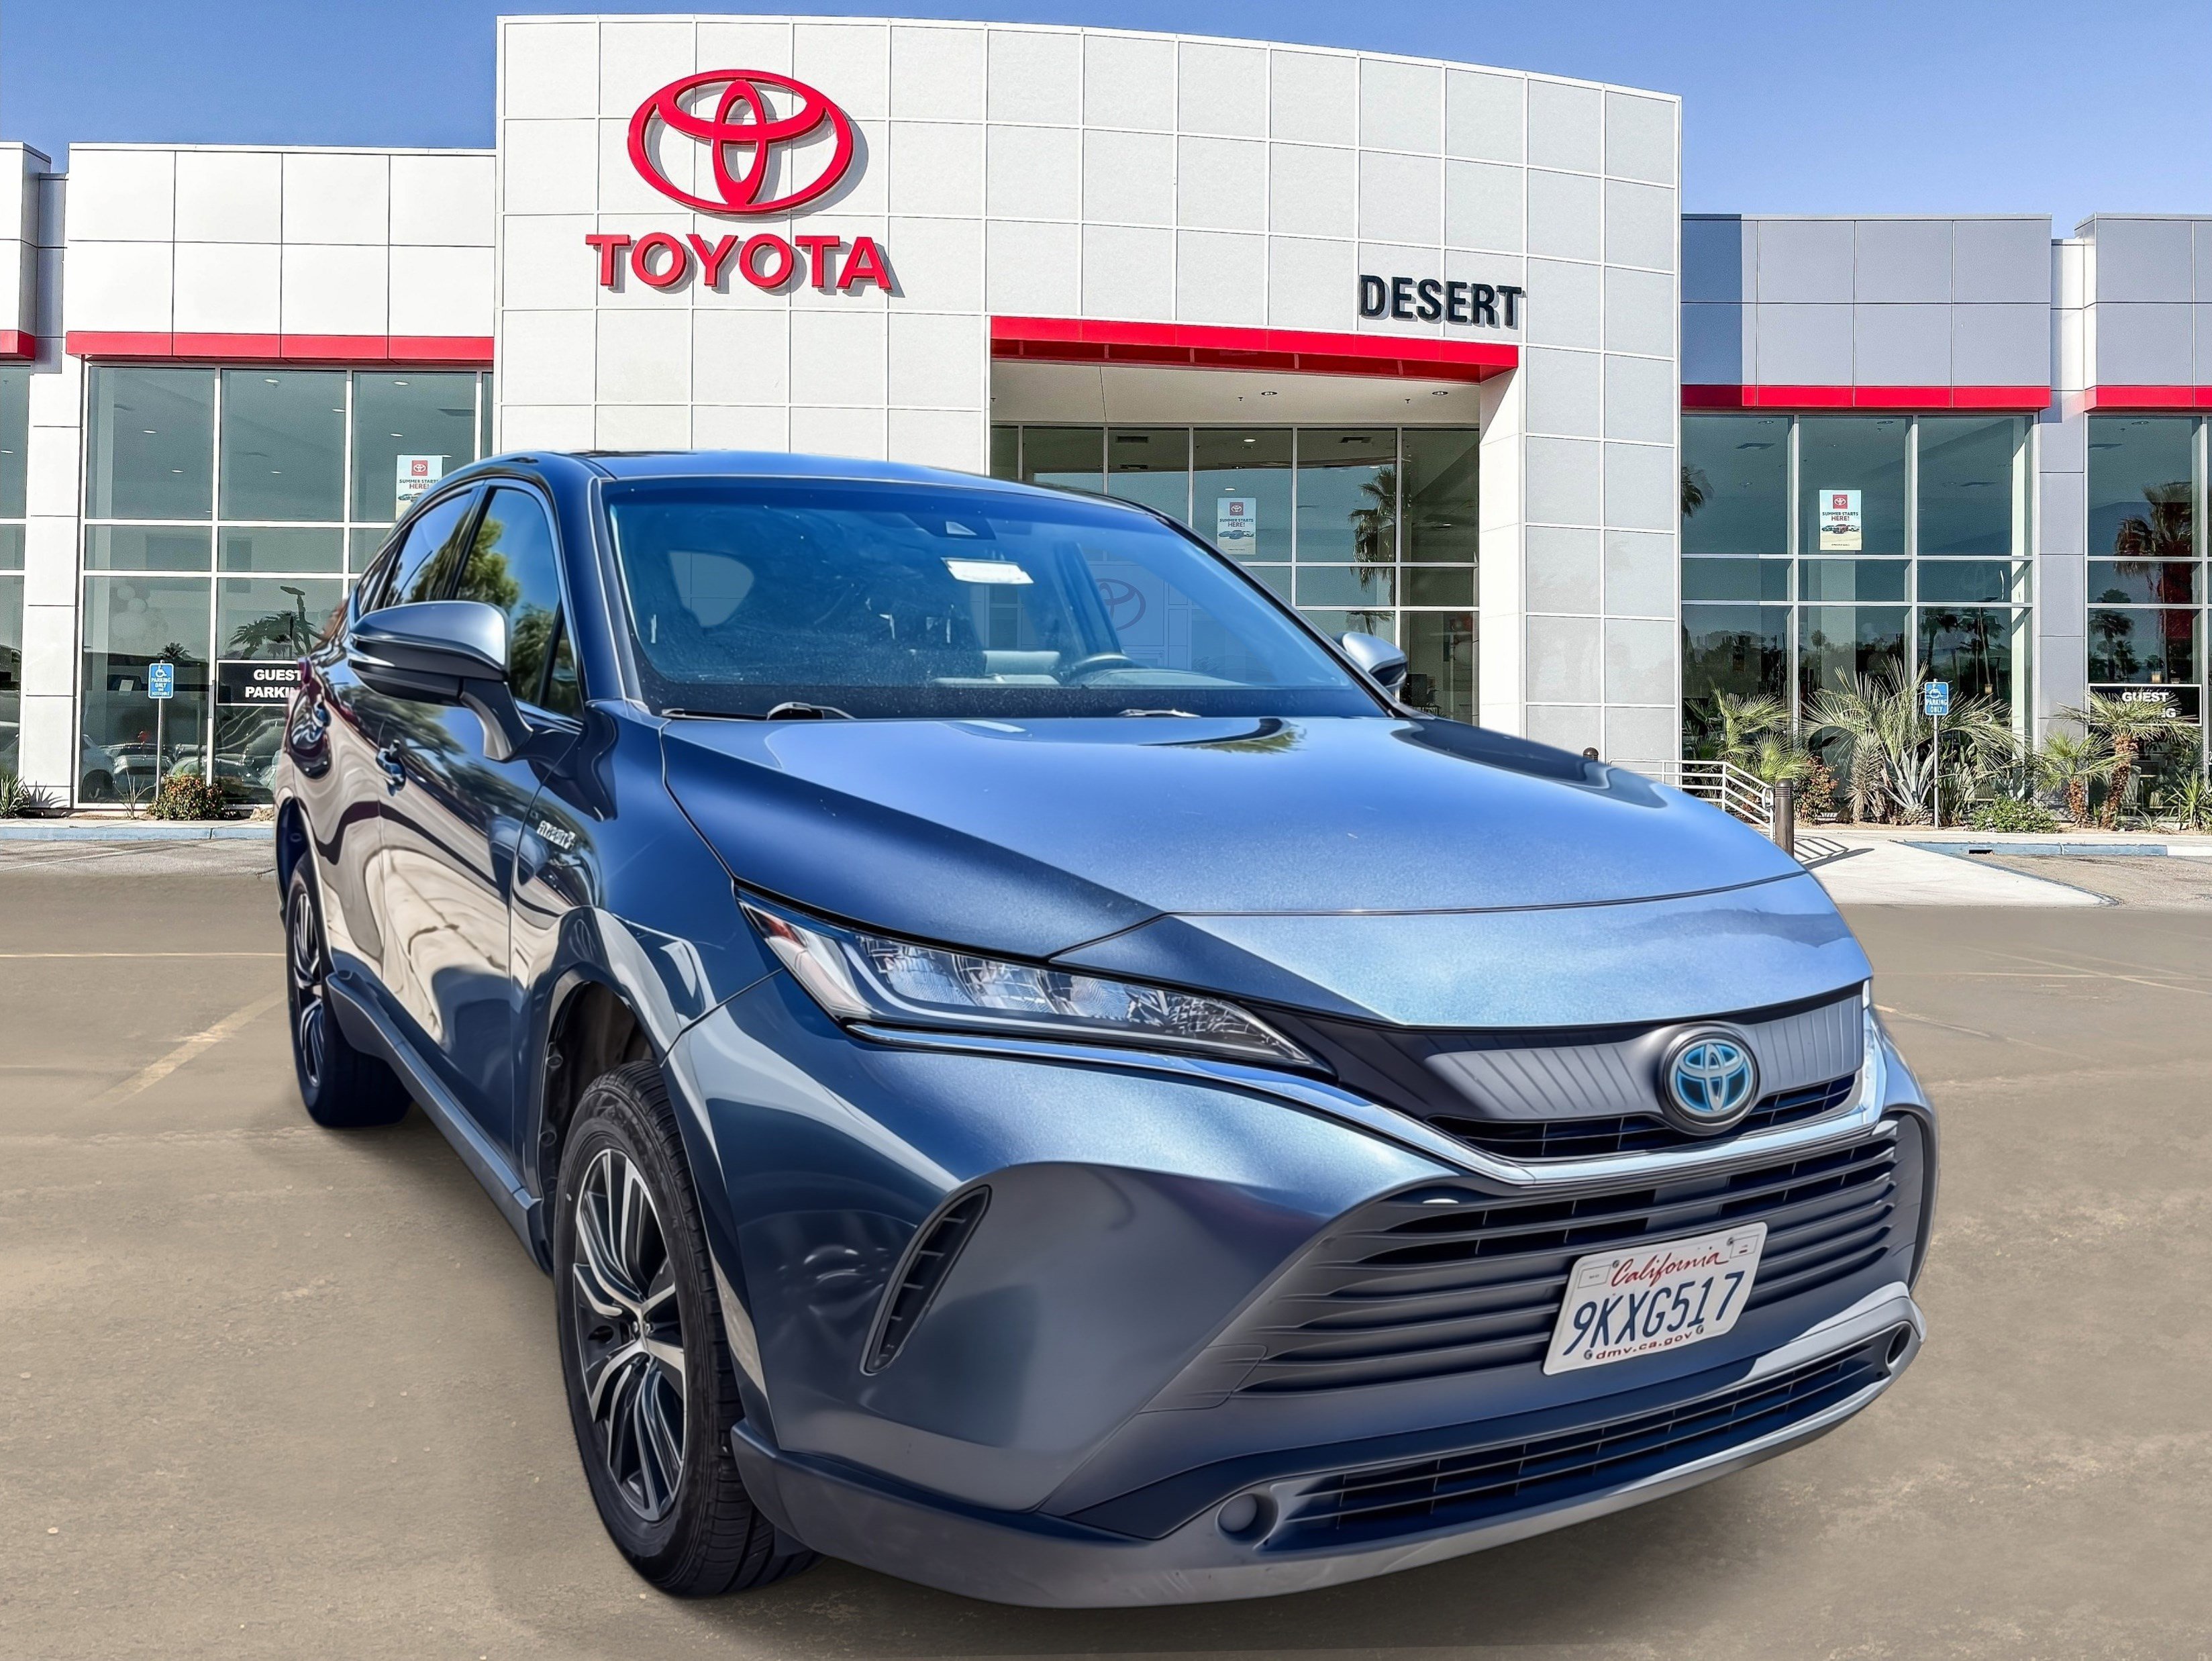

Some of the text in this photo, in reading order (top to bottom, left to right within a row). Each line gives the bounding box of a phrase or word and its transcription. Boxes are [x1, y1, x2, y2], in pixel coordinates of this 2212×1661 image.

[585, 232, 893, 290] TOYOTA
[1359, 274, 1522, 326] DESERT
[253, 669, 303, 681] GUEST
[245, 686, 291, 698] PARKI
[1926, 698, 1947, 706] PARKING
[2121, 691, 2169, 703] GUEST
[1611, 1252, 1729, 1287] California
[1562, 1270, 1745, 1356] 9KXG517
[1596, 1331, 1693, 1360] dmv.ca.gov
